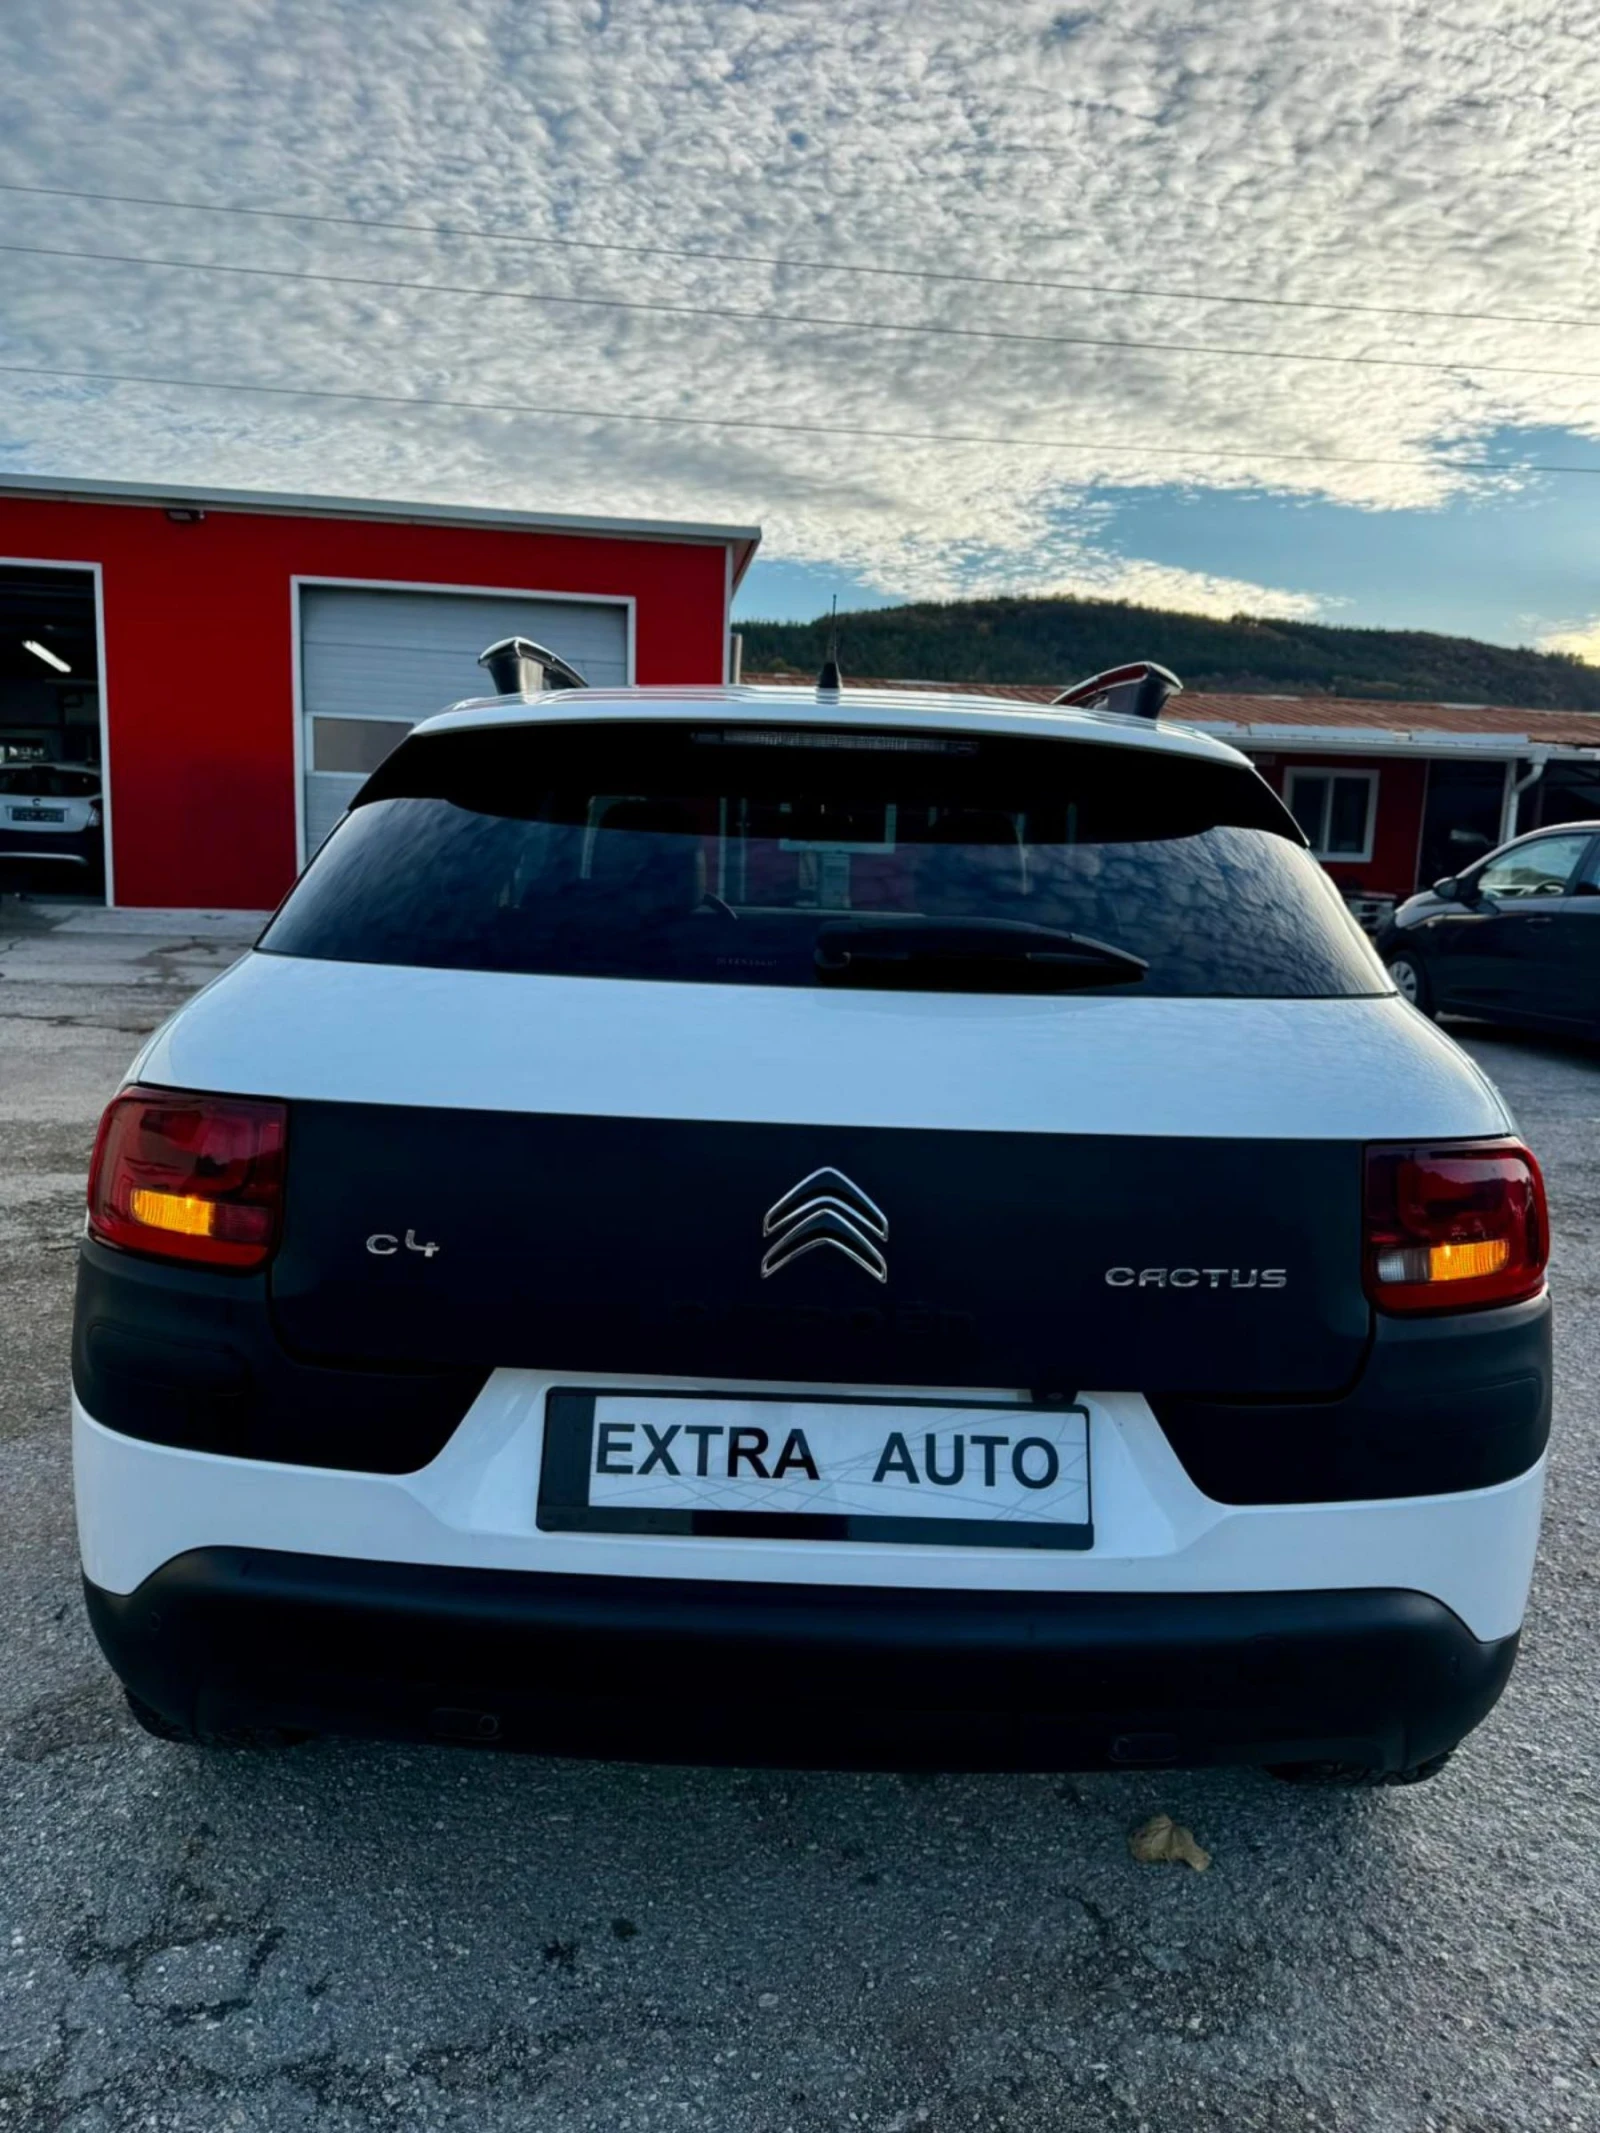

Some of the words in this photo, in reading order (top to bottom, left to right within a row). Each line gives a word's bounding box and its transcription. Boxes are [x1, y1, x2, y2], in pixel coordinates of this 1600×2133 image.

[366, 1229, 440, 1258] C4
[1105, 1267, 1287, 1288] CACTUS
[596, 1423, 820, 1481] EXTRA
[872, 1432, 1060, 1489] AUTO
